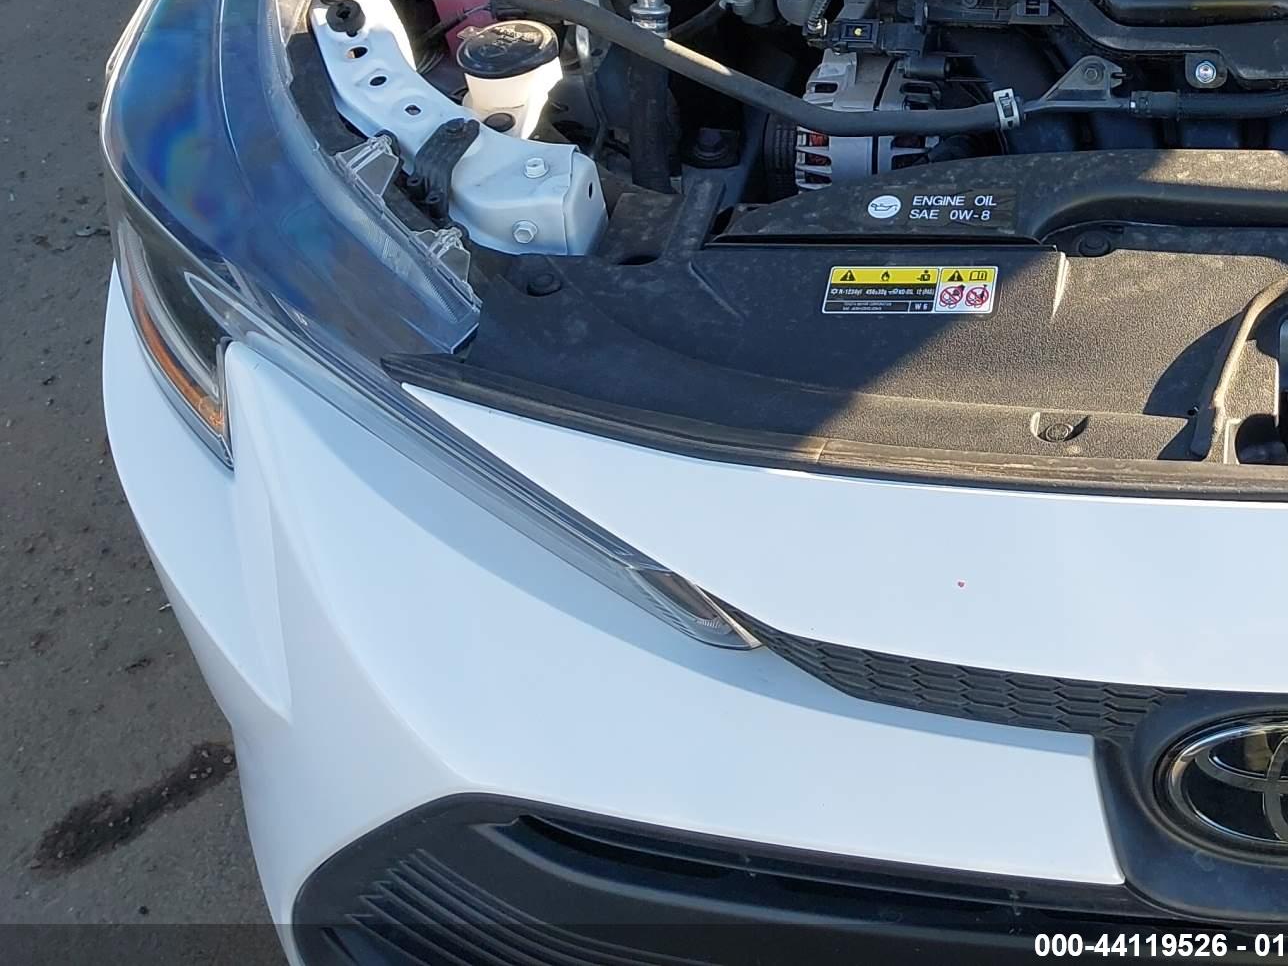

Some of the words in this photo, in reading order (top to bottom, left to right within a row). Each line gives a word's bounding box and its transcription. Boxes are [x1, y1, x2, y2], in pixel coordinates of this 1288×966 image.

[912, 195, 966, 206] ENGINE
[974, 195, 997, 206] OIL
[909, 209, 940, 220] SAE
[949, 209, 991, 221] 0W-8
